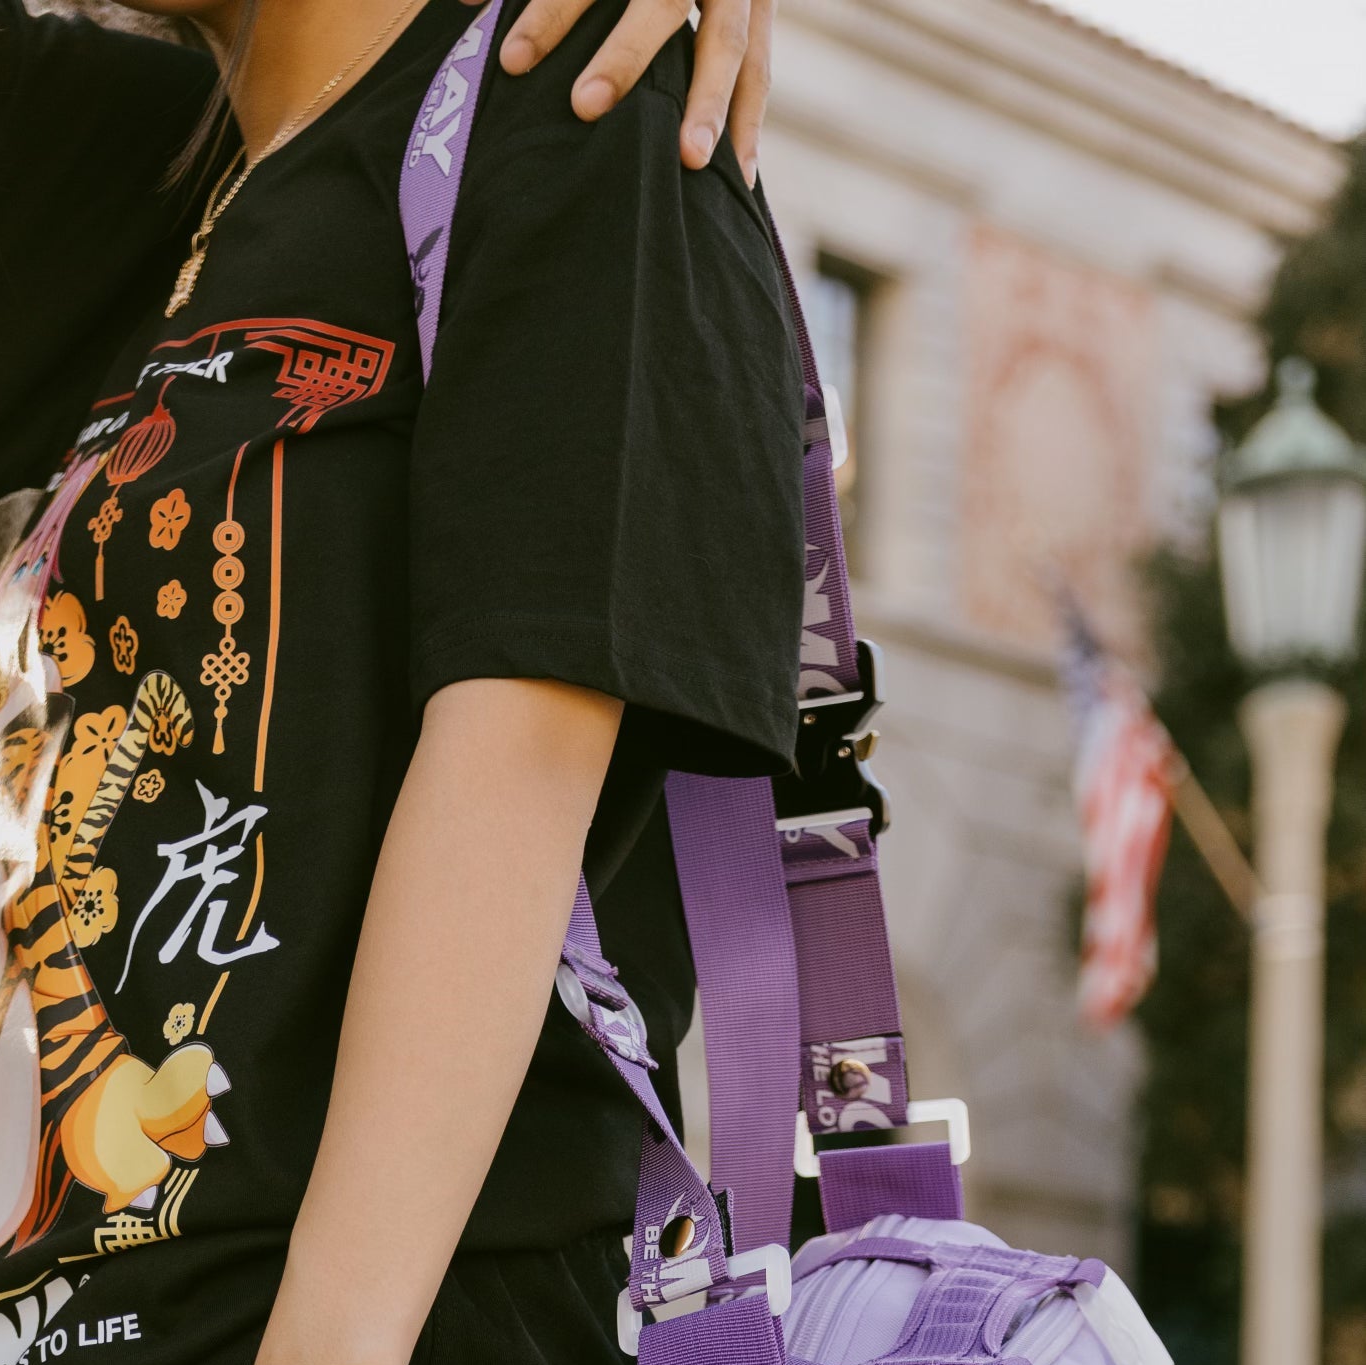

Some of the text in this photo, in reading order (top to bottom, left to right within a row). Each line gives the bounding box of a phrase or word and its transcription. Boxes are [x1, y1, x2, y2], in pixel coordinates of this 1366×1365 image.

[644, 1225, 660, 1260] BE
[35, 1313, 142, 1363] TO LIFE
